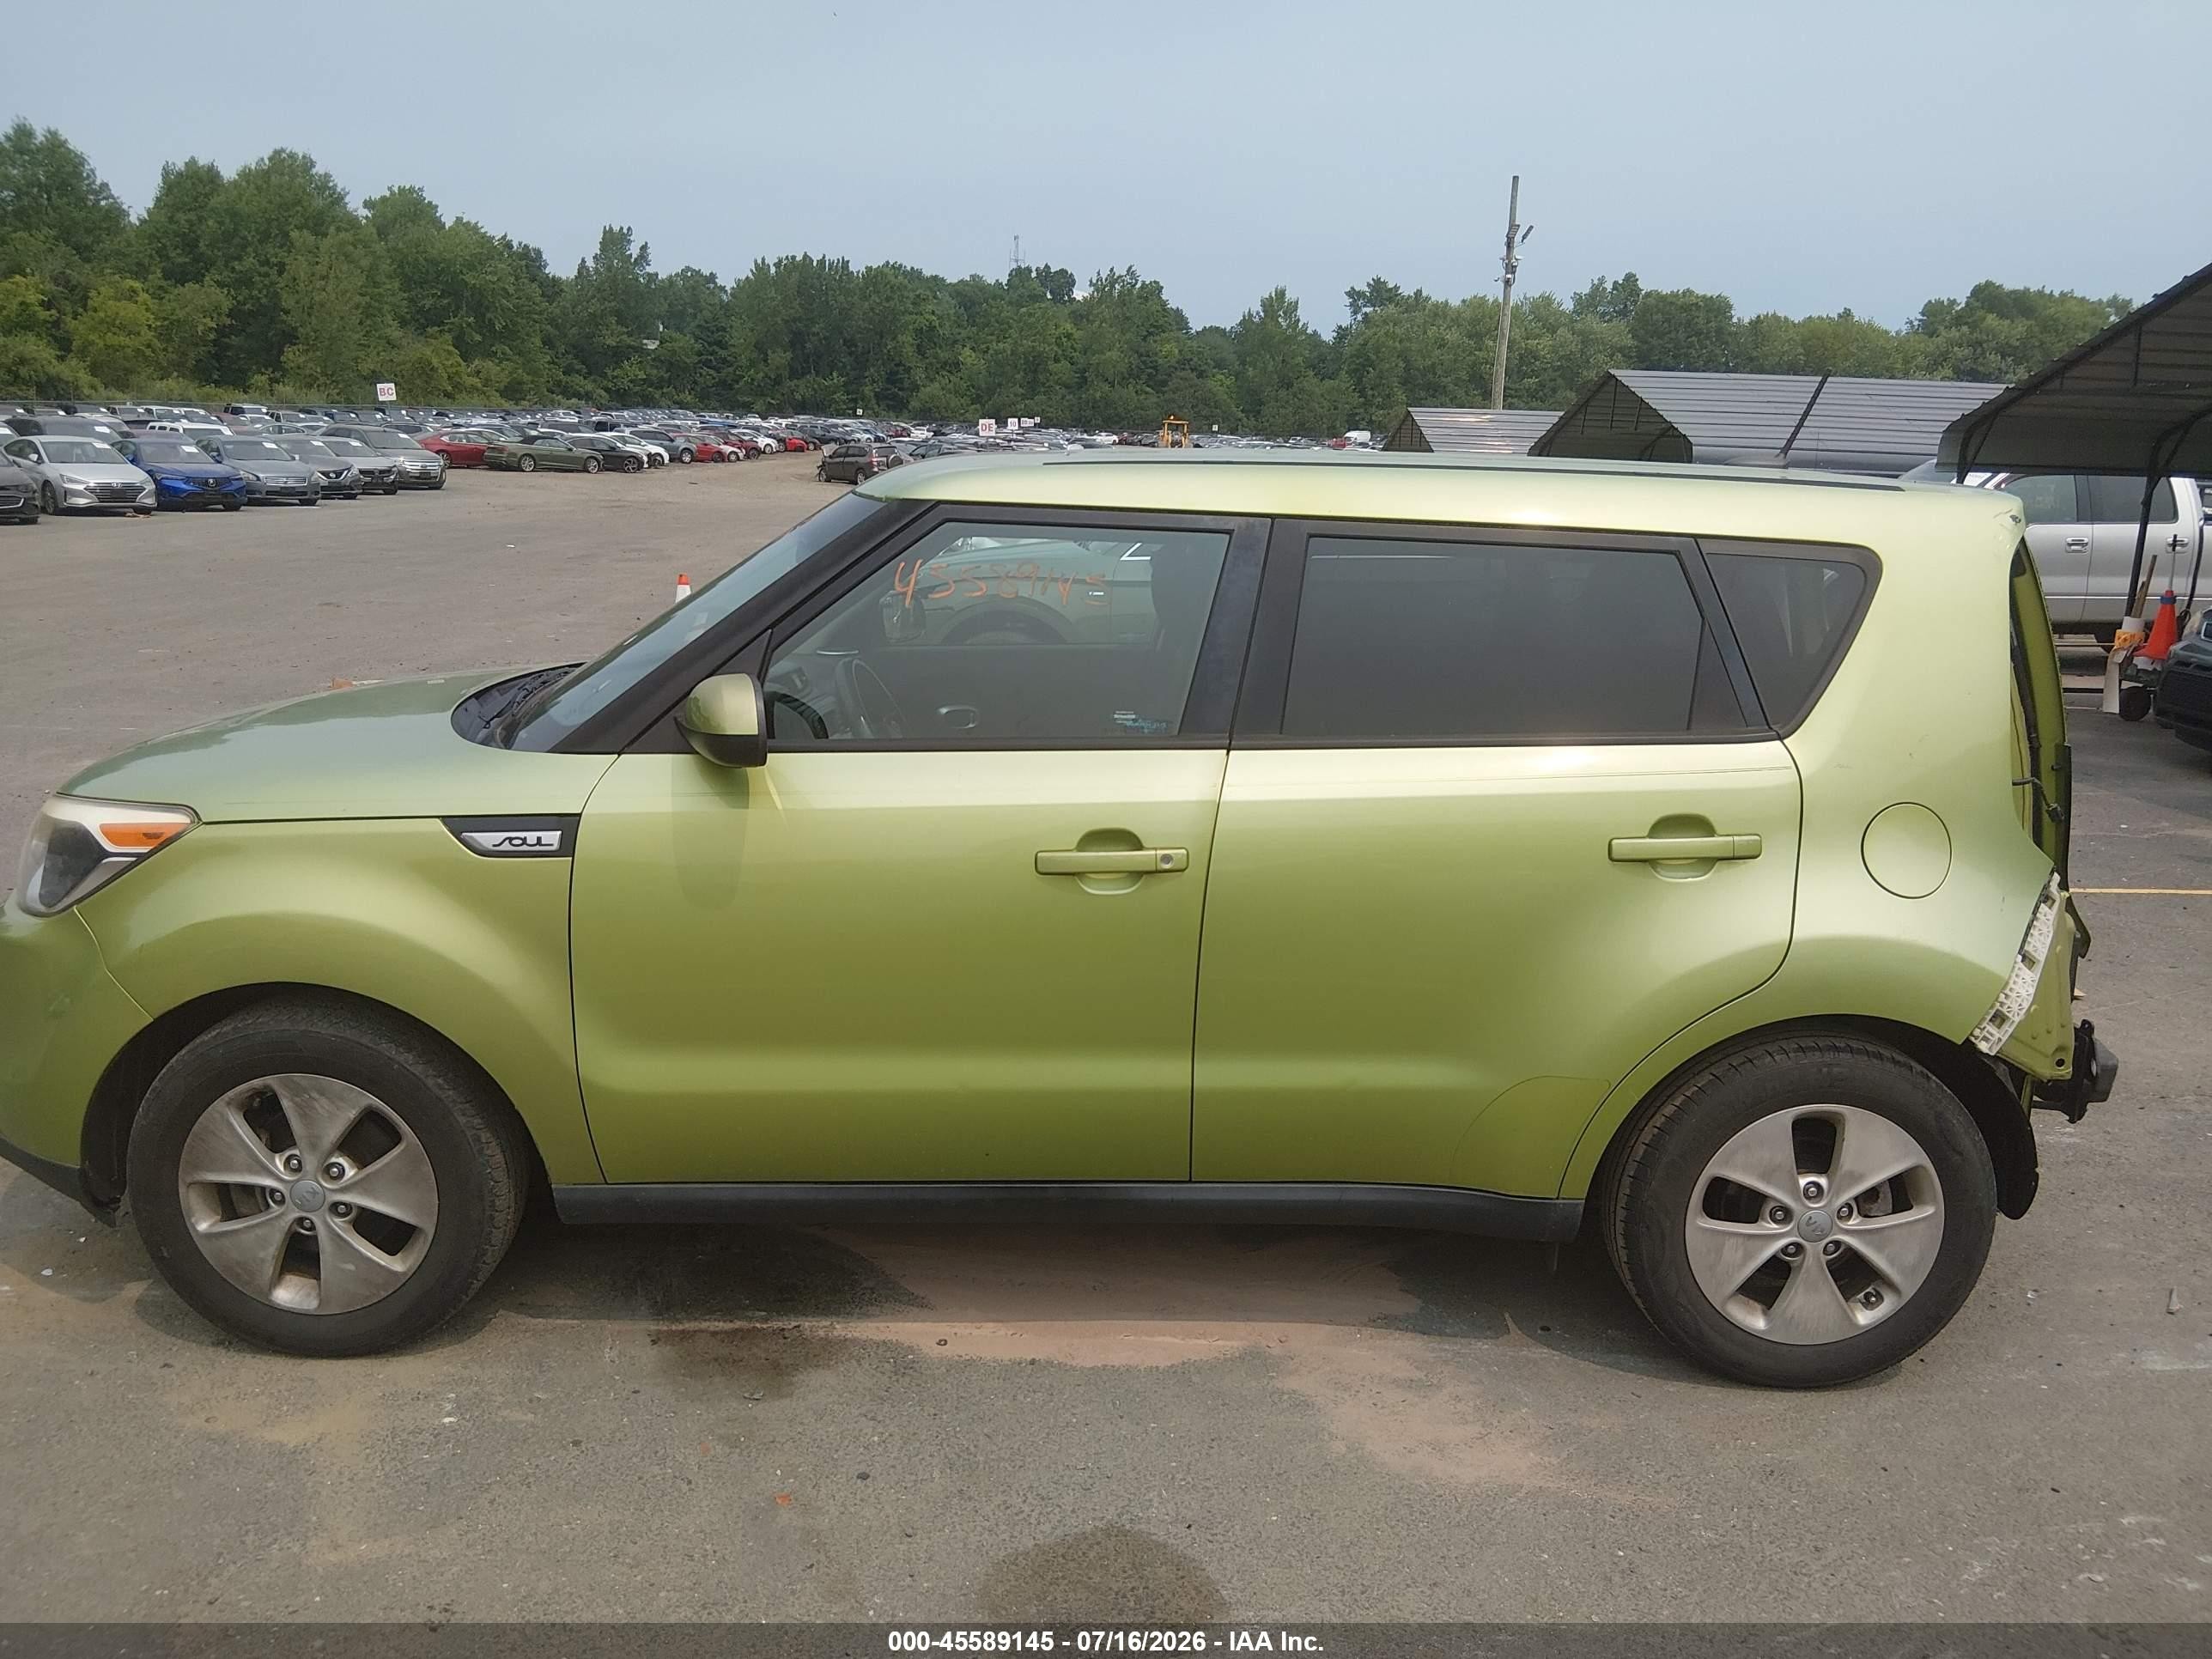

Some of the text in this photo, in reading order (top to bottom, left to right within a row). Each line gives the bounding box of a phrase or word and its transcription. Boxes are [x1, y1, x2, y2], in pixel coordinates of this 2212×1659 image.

[379, 387, 394, 396] BC
[981, 423, 994, 432] DE
[894, 559, 1109, 607] 45589145
[492, 836, 554, 847] SOUL
